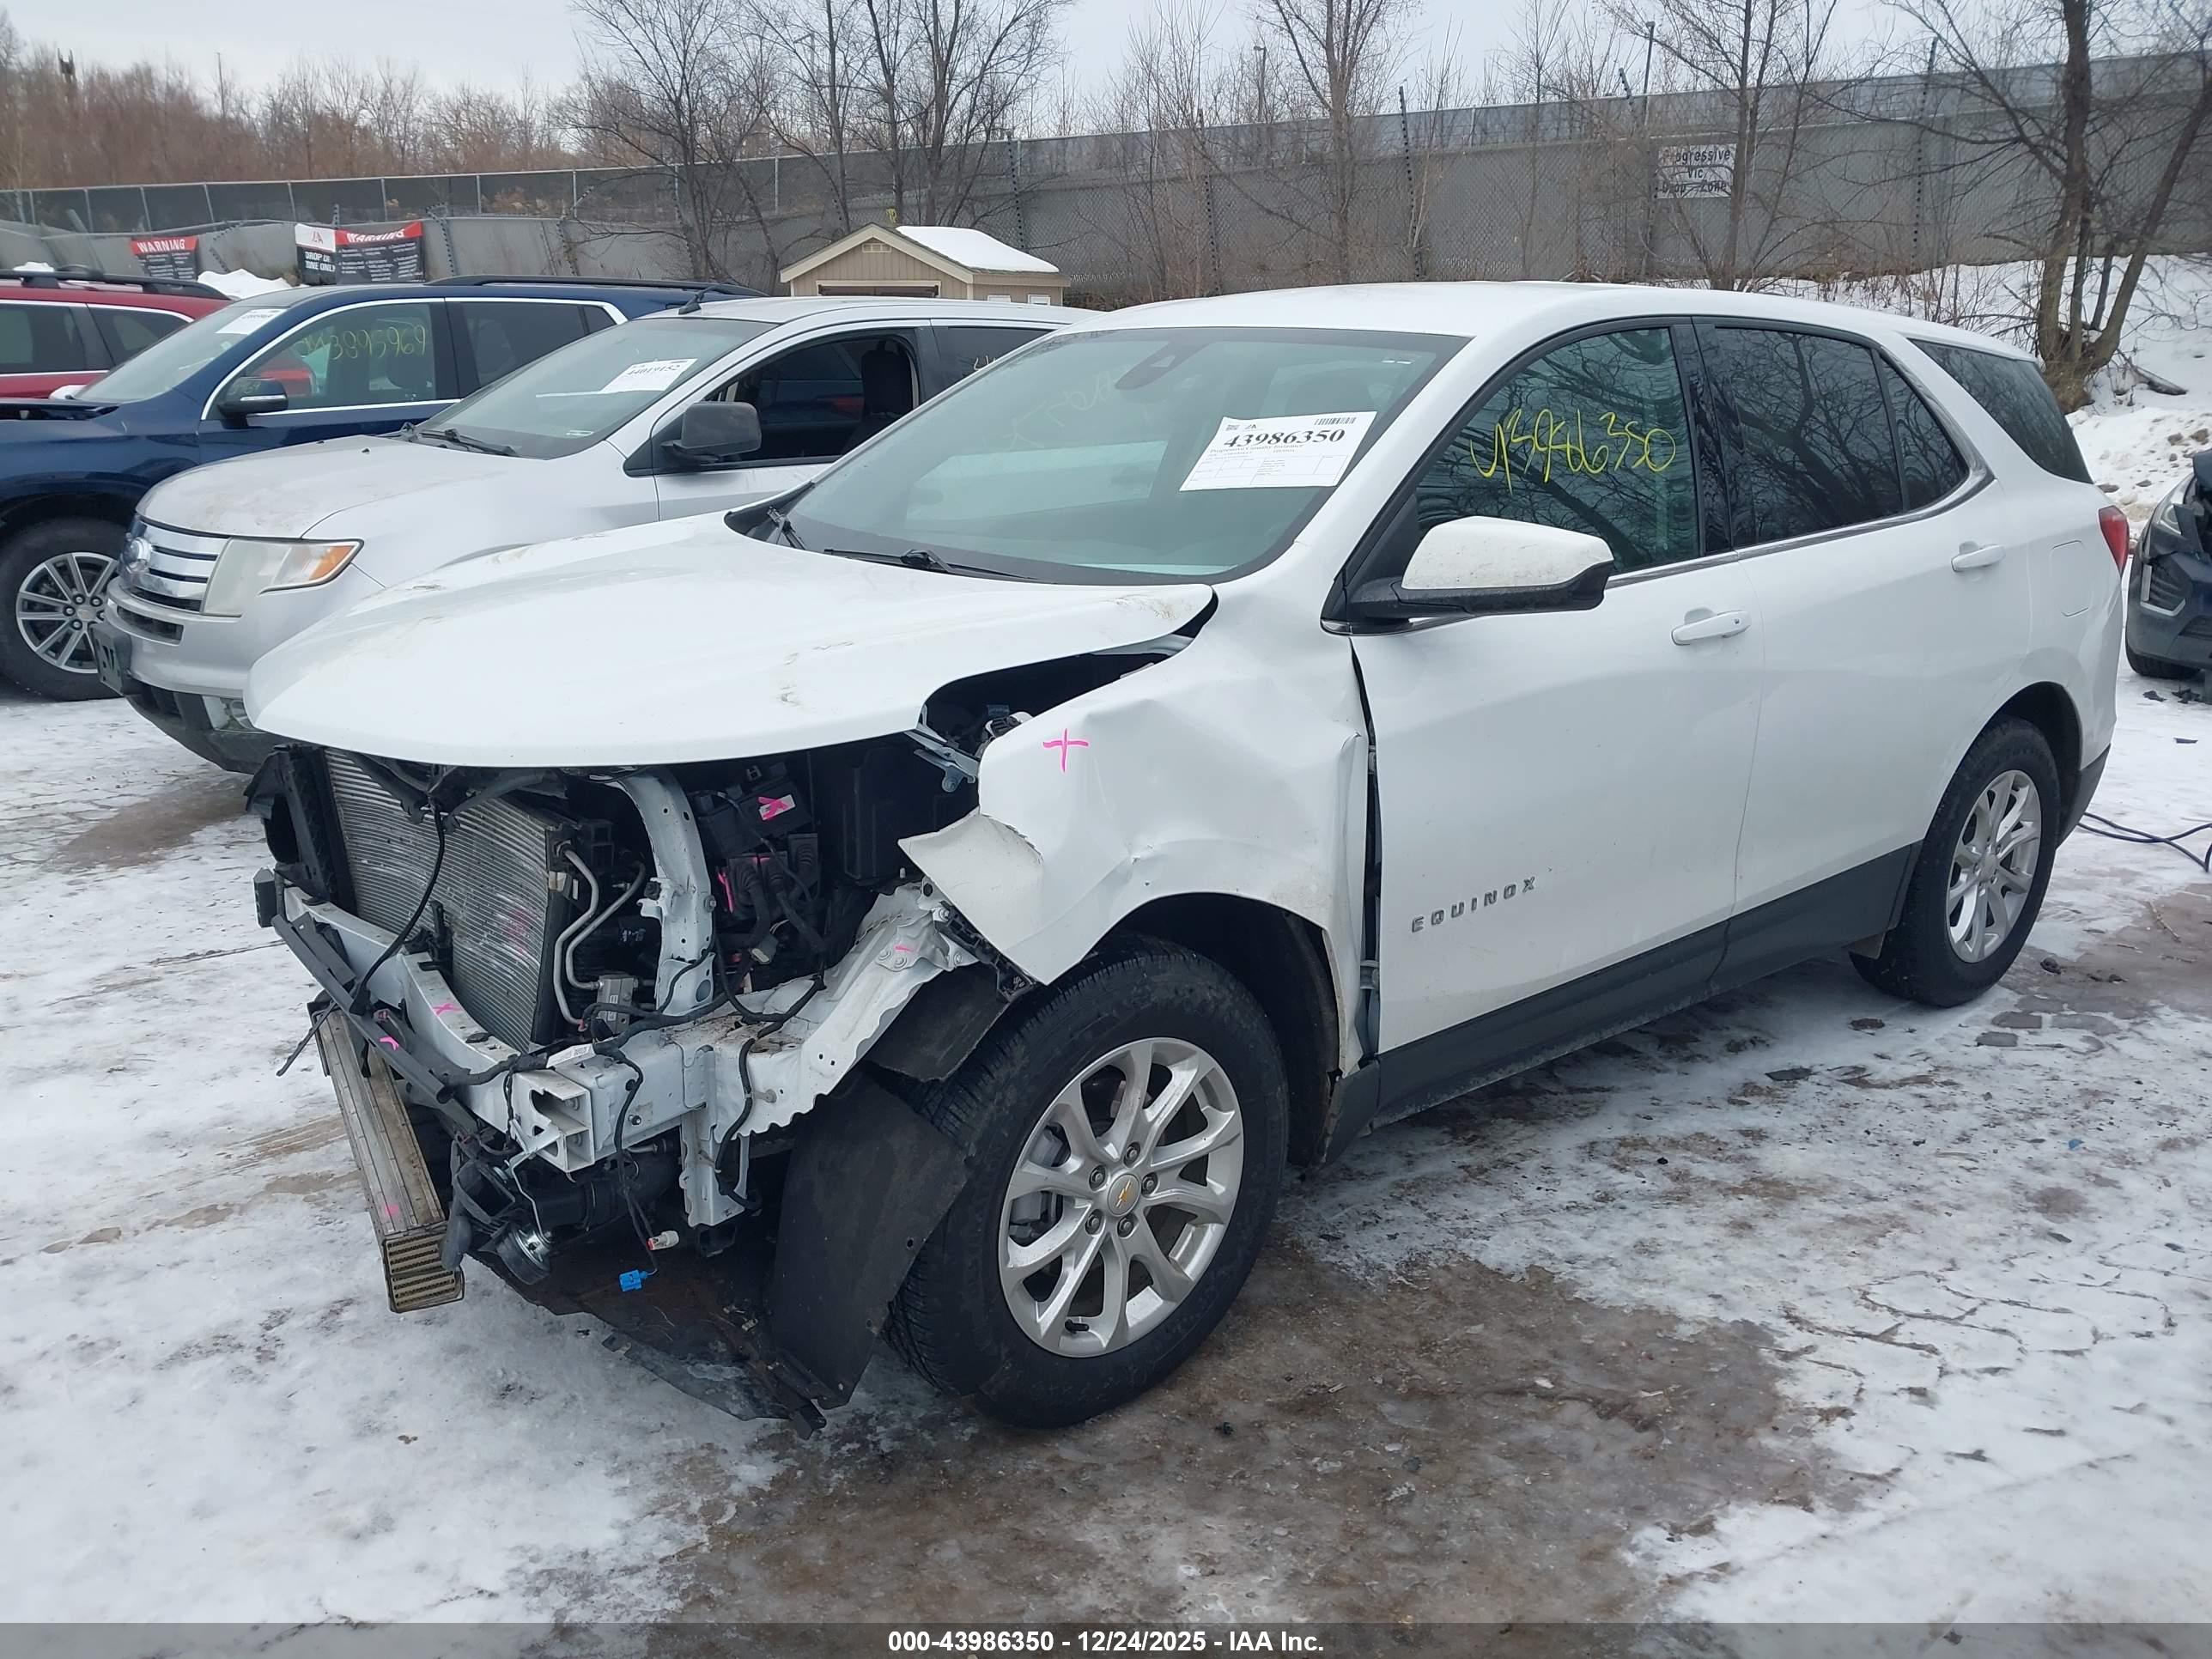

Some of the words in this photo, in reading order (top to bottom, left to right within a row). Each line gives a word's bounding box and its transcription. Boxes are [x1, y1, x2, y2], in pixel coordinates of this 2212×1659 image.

[1662, 149, 1730, 165] ogressive
[1662, 182, 1686, 195] Dop
[347, 228, 405, 243] WARNING
[137, 239, 185, 252] WARNING
[305, 251, 322, 261] DROP
[1224, 429, 1346, 447] 43986350
[1470, 408, 1676, 496] 43986350
[1411, 876, 1535, 933] EQUINOX
